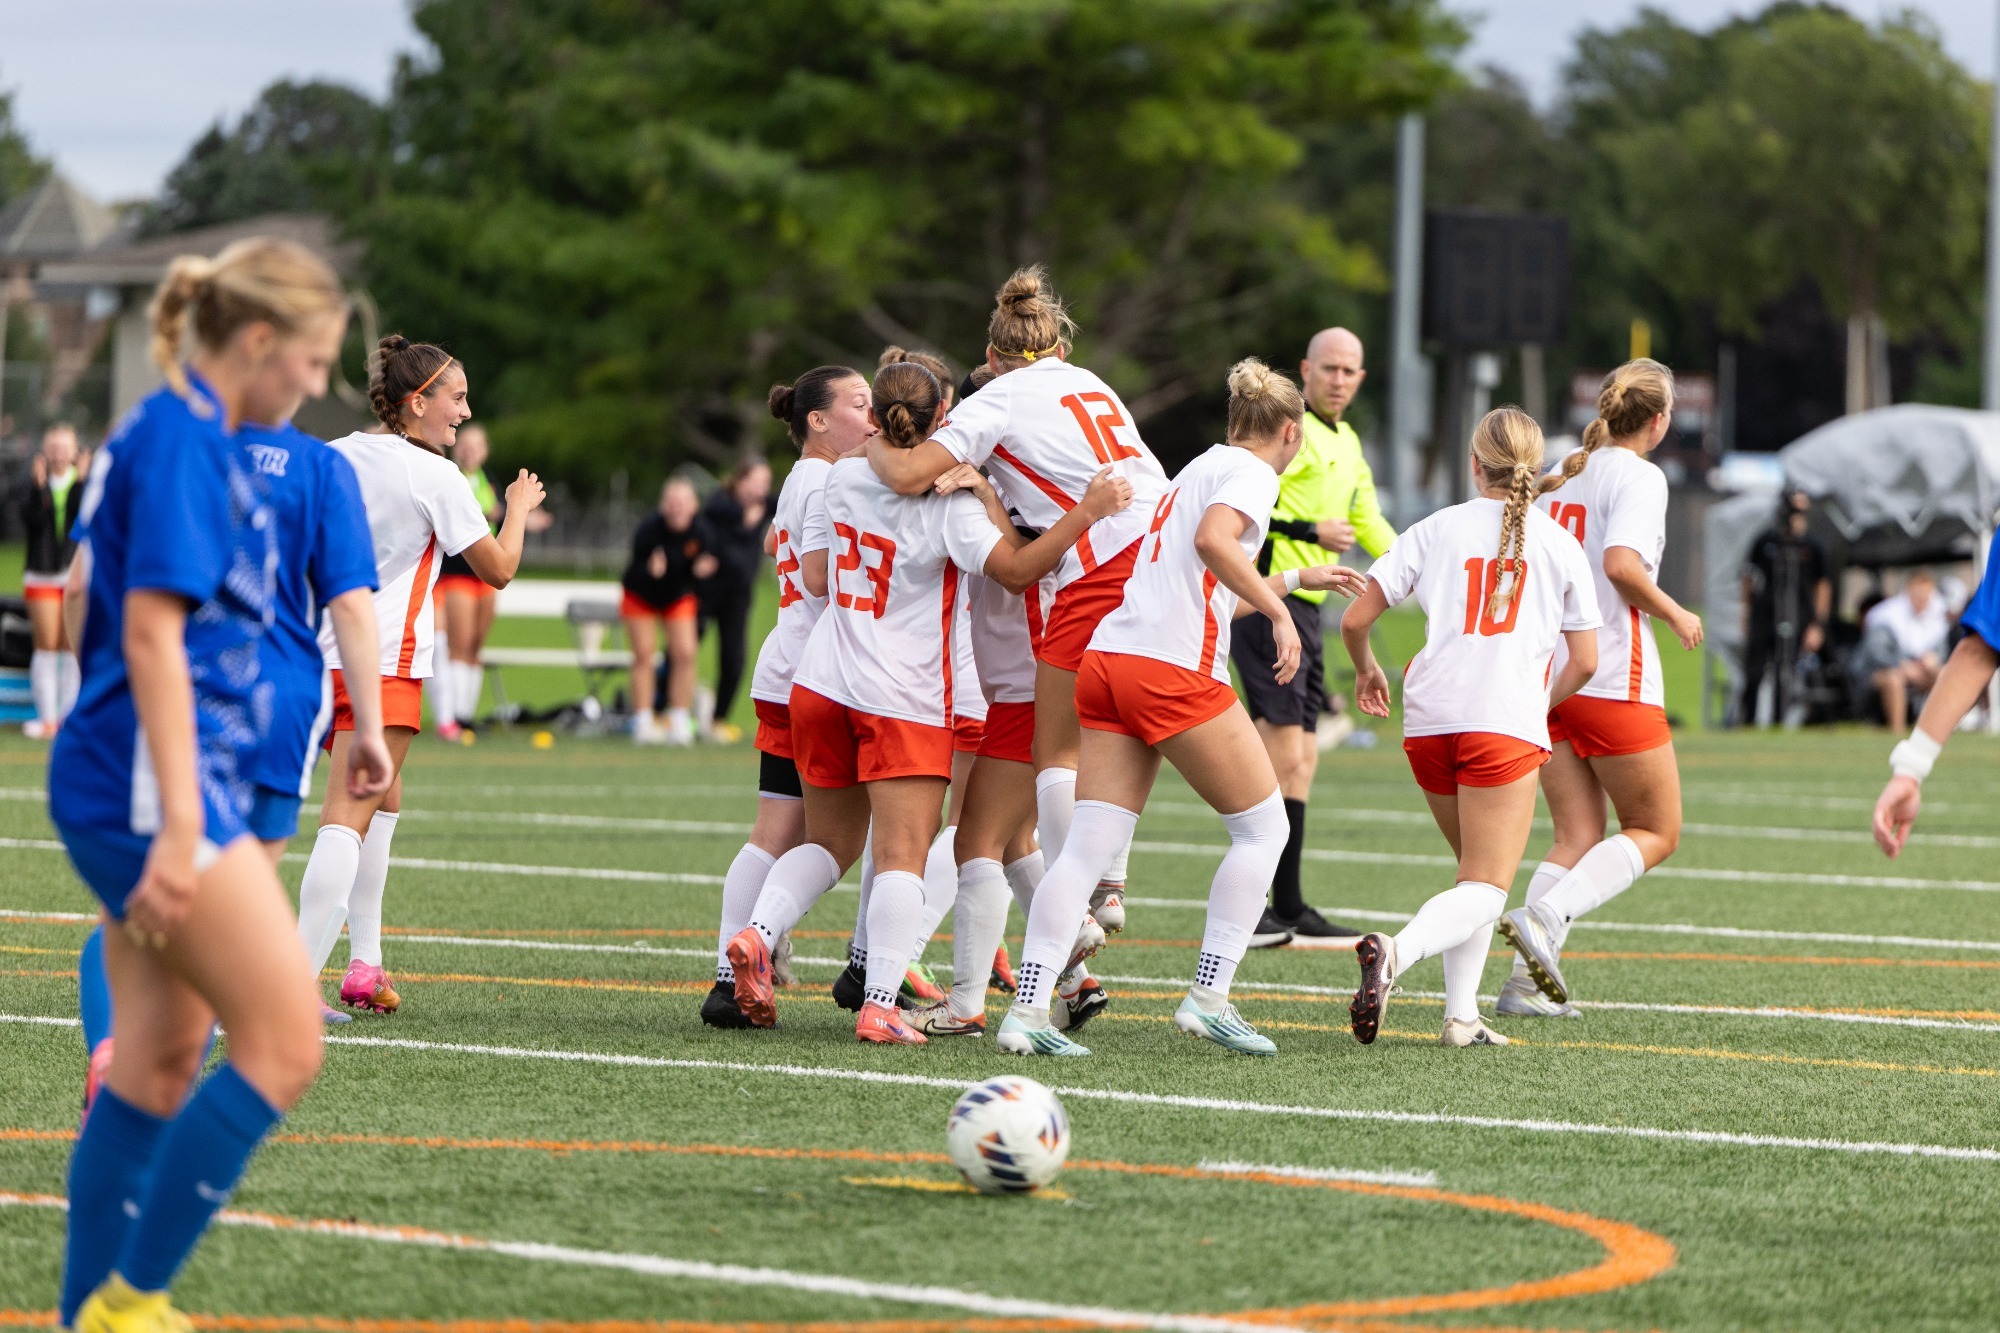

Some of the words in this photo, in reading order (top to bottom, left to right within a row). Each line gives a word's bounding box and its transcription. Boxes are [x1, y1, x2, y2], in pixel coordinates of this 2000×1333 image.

[1060, 391, 1142, 464] 12
[1149, 486, 1181, 563] 4
[833, 521, 897, 620] 23
[1463, 557, 1528, 637] 10
